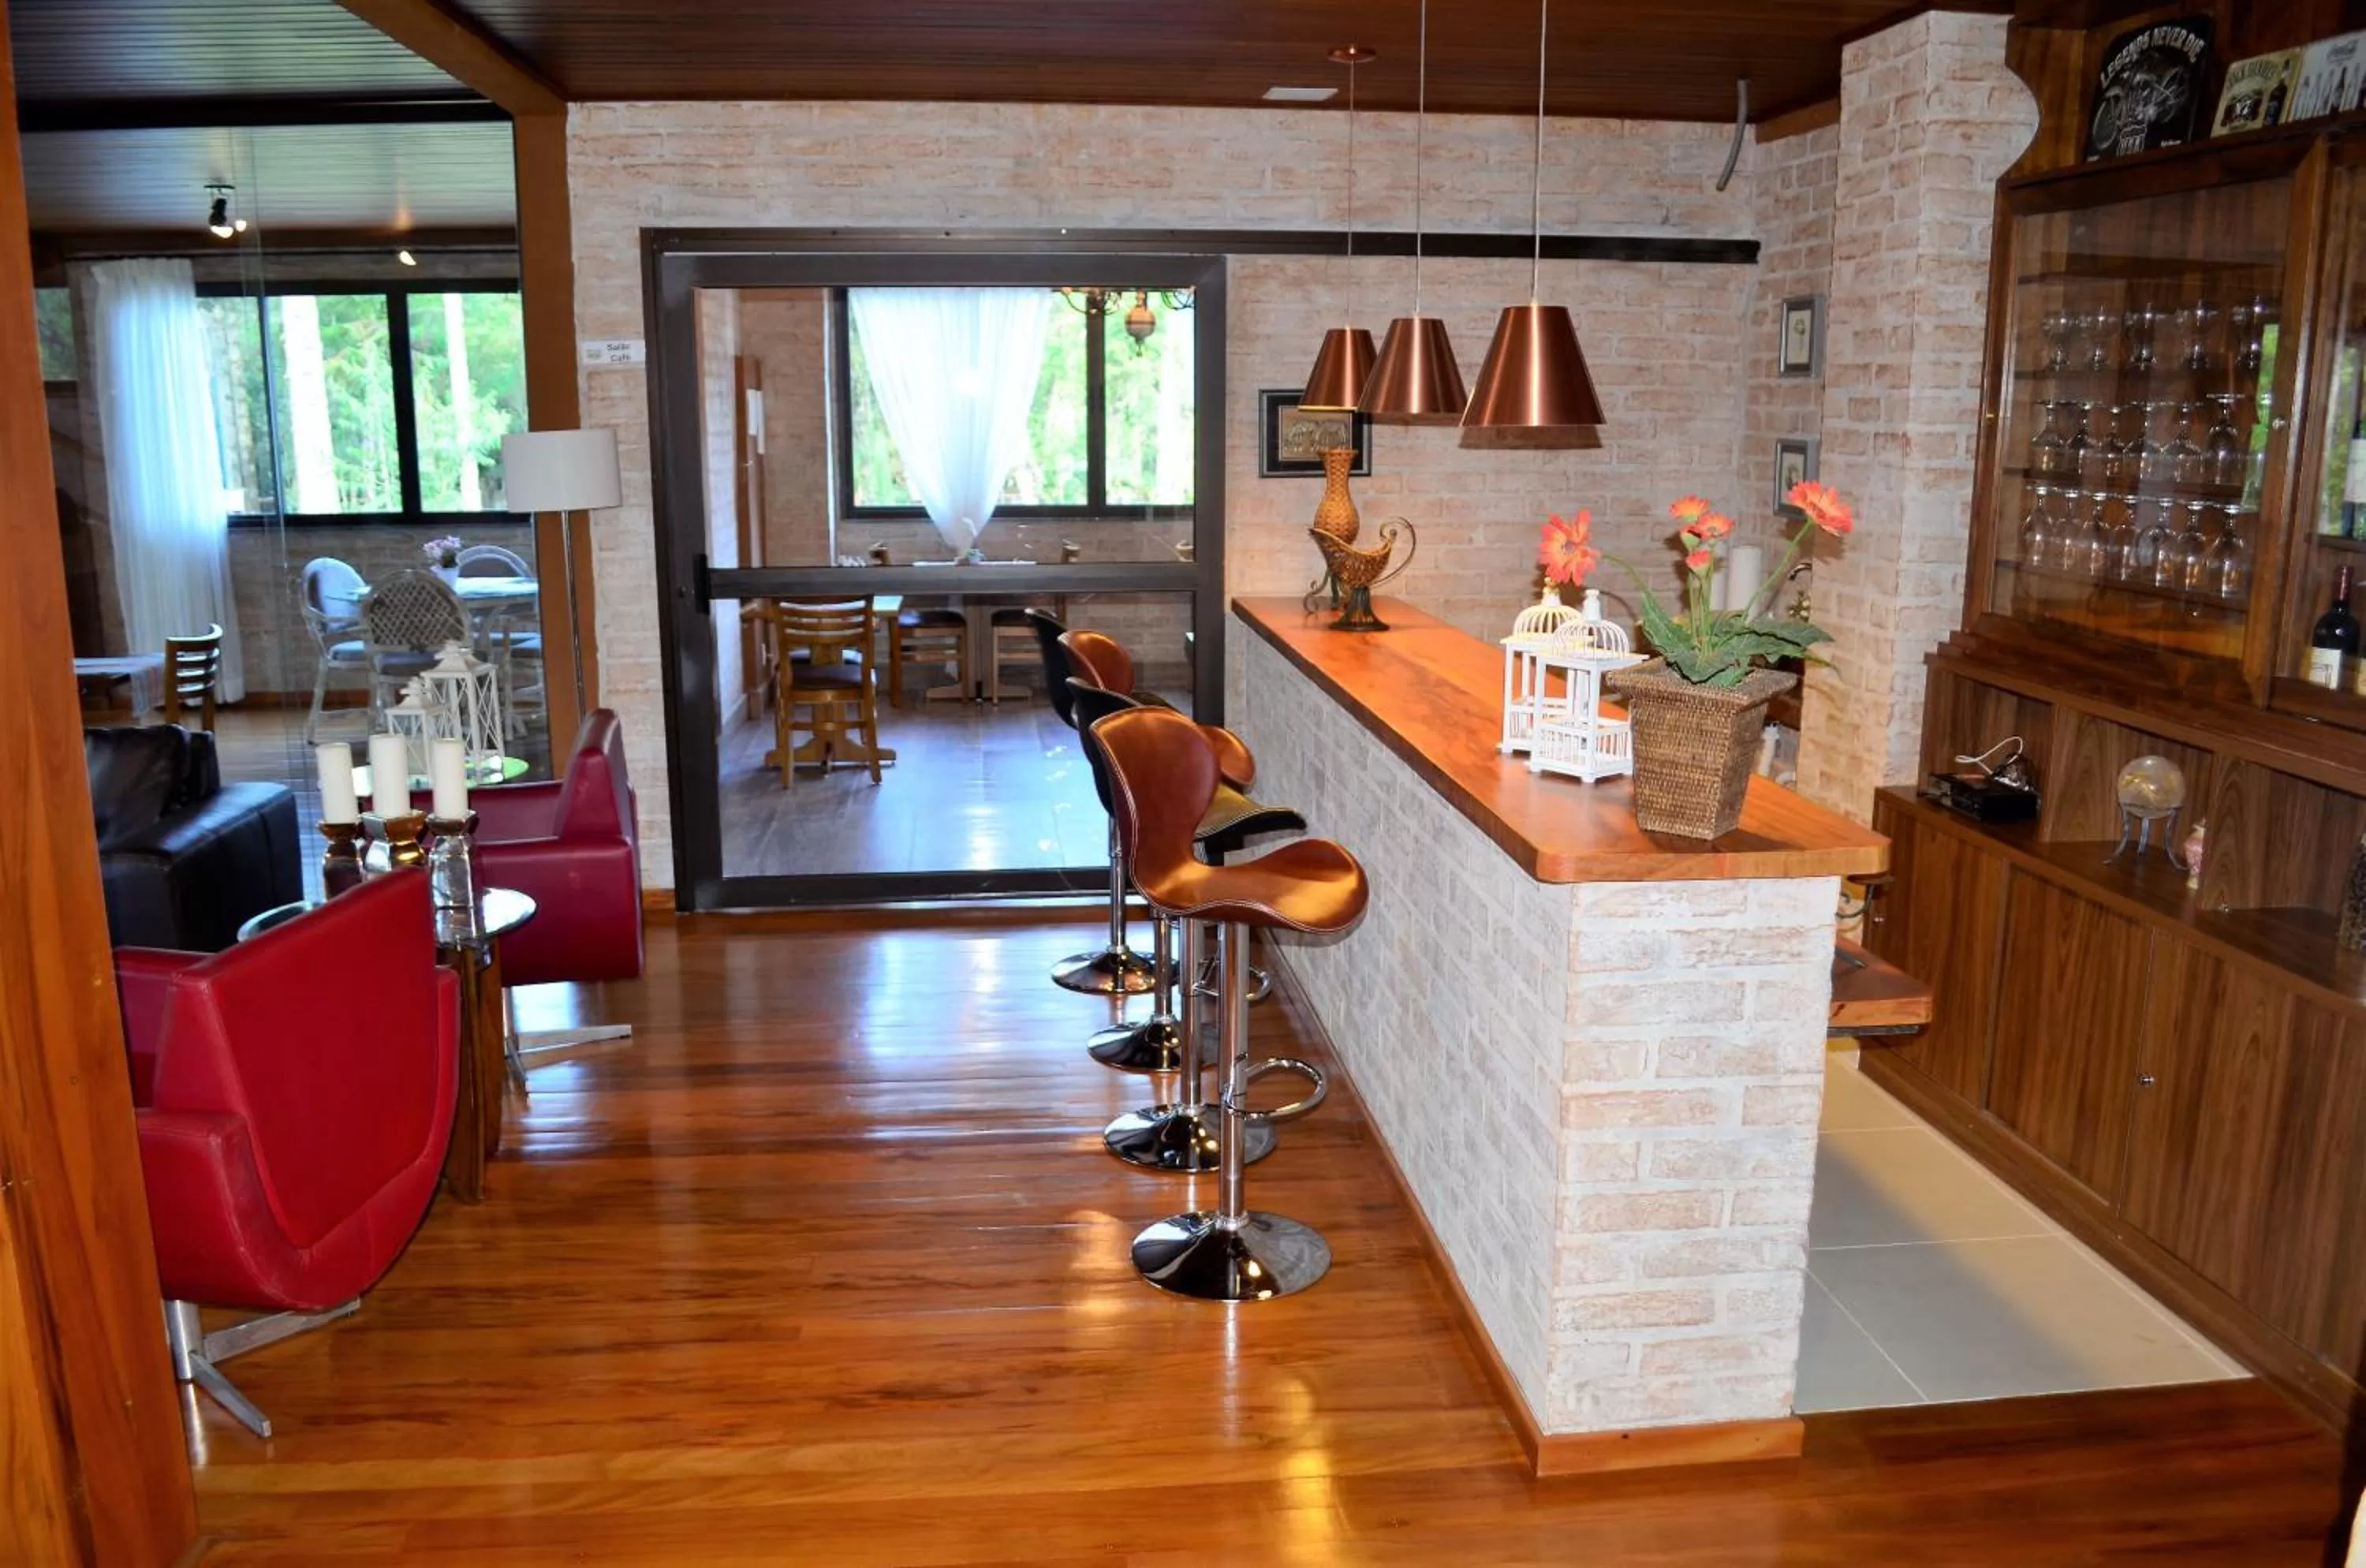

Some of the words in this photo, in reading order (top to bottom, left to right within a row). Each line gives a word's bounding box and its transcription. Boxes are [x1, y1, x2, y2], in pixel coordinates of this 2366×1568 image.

[2099, 29, 2151, 90] LEGENDS
[2152, 26, 2187, 49] NEVER
[2182, 32, 2206, 64] DIE
